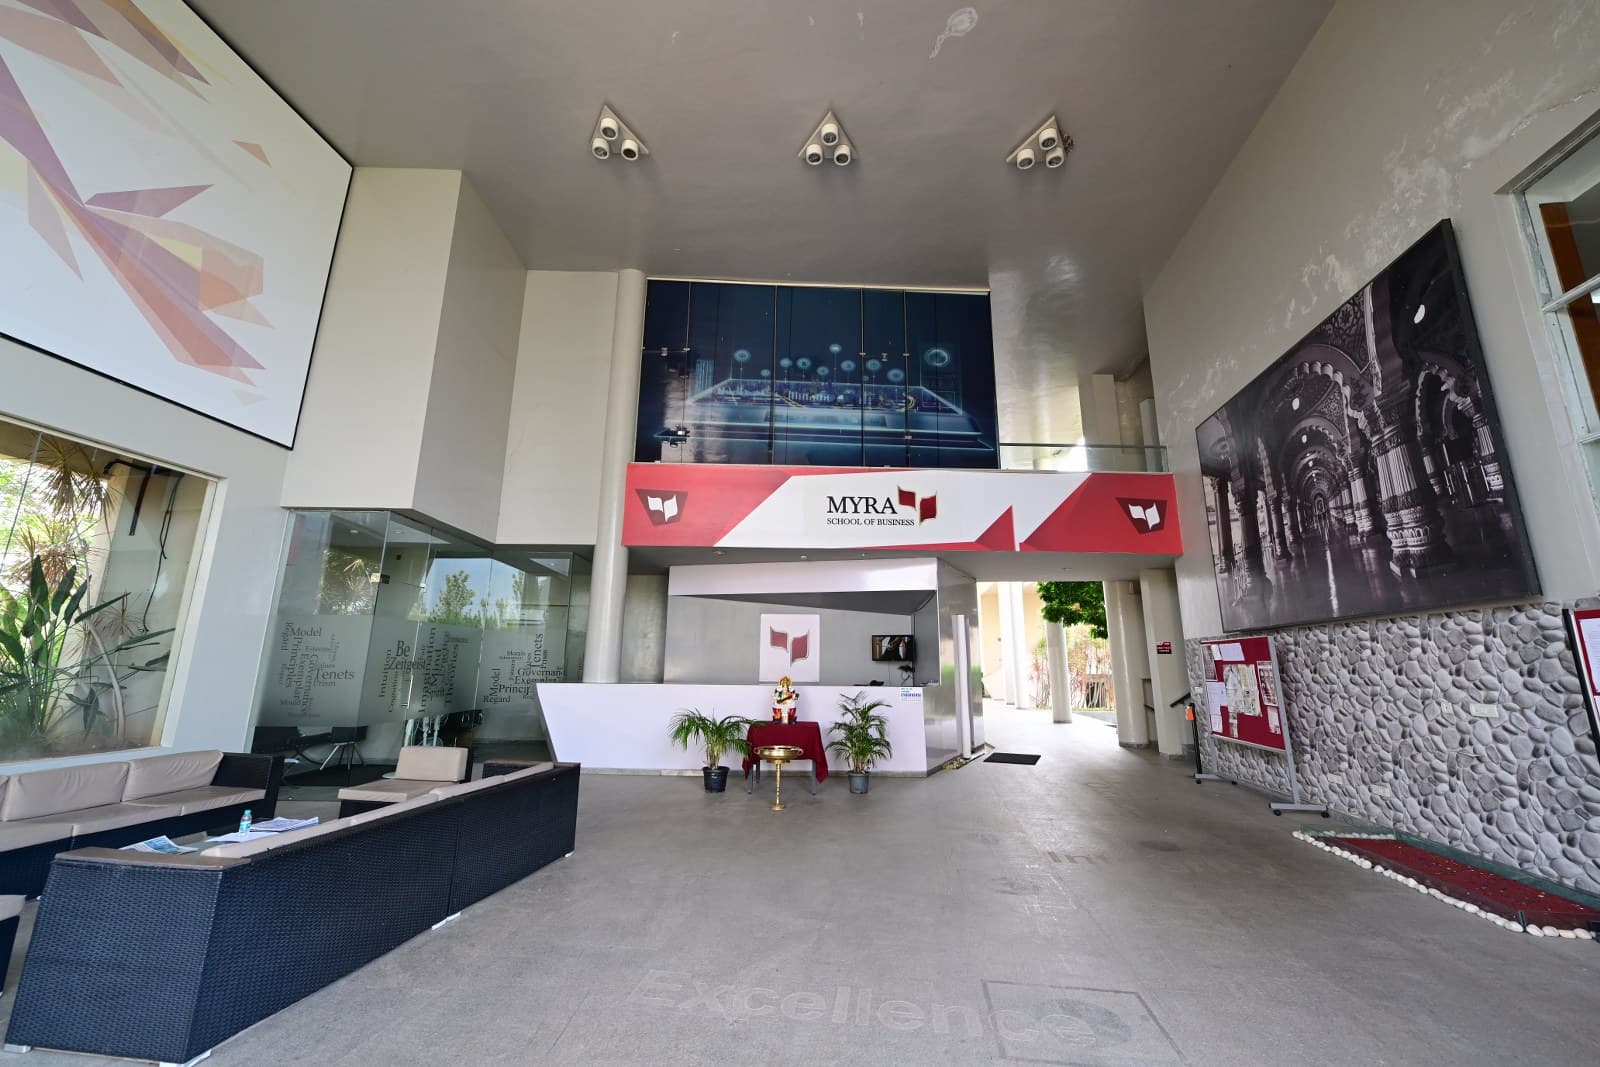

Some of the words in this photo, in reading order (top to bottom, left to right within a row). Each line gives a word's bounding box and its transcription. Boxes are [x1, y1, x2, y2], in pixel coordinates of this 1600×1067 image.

[826, 495, 897, 514] MYRA
[826, 517, 862, 526] SCHOOL
[863, 518, 875, 526] OF
[877, 518, 915, 527] BUSINESS
[290, 626, 322, 637] Model
[396, 640, 410, 657] Be
[530, 633, 543, 667] Tenets
[285, 637, 304, 688] Principles
[389, 656, 426, 673] Zeitgeist
[316, 669, 355, 680] Tenets
[377, 649, 392, 698] Intuition
[489, 668, 501, 697] Model
[483, 695, 511, 704] Regard
[627, 968, 1097, 1047] Excellence
